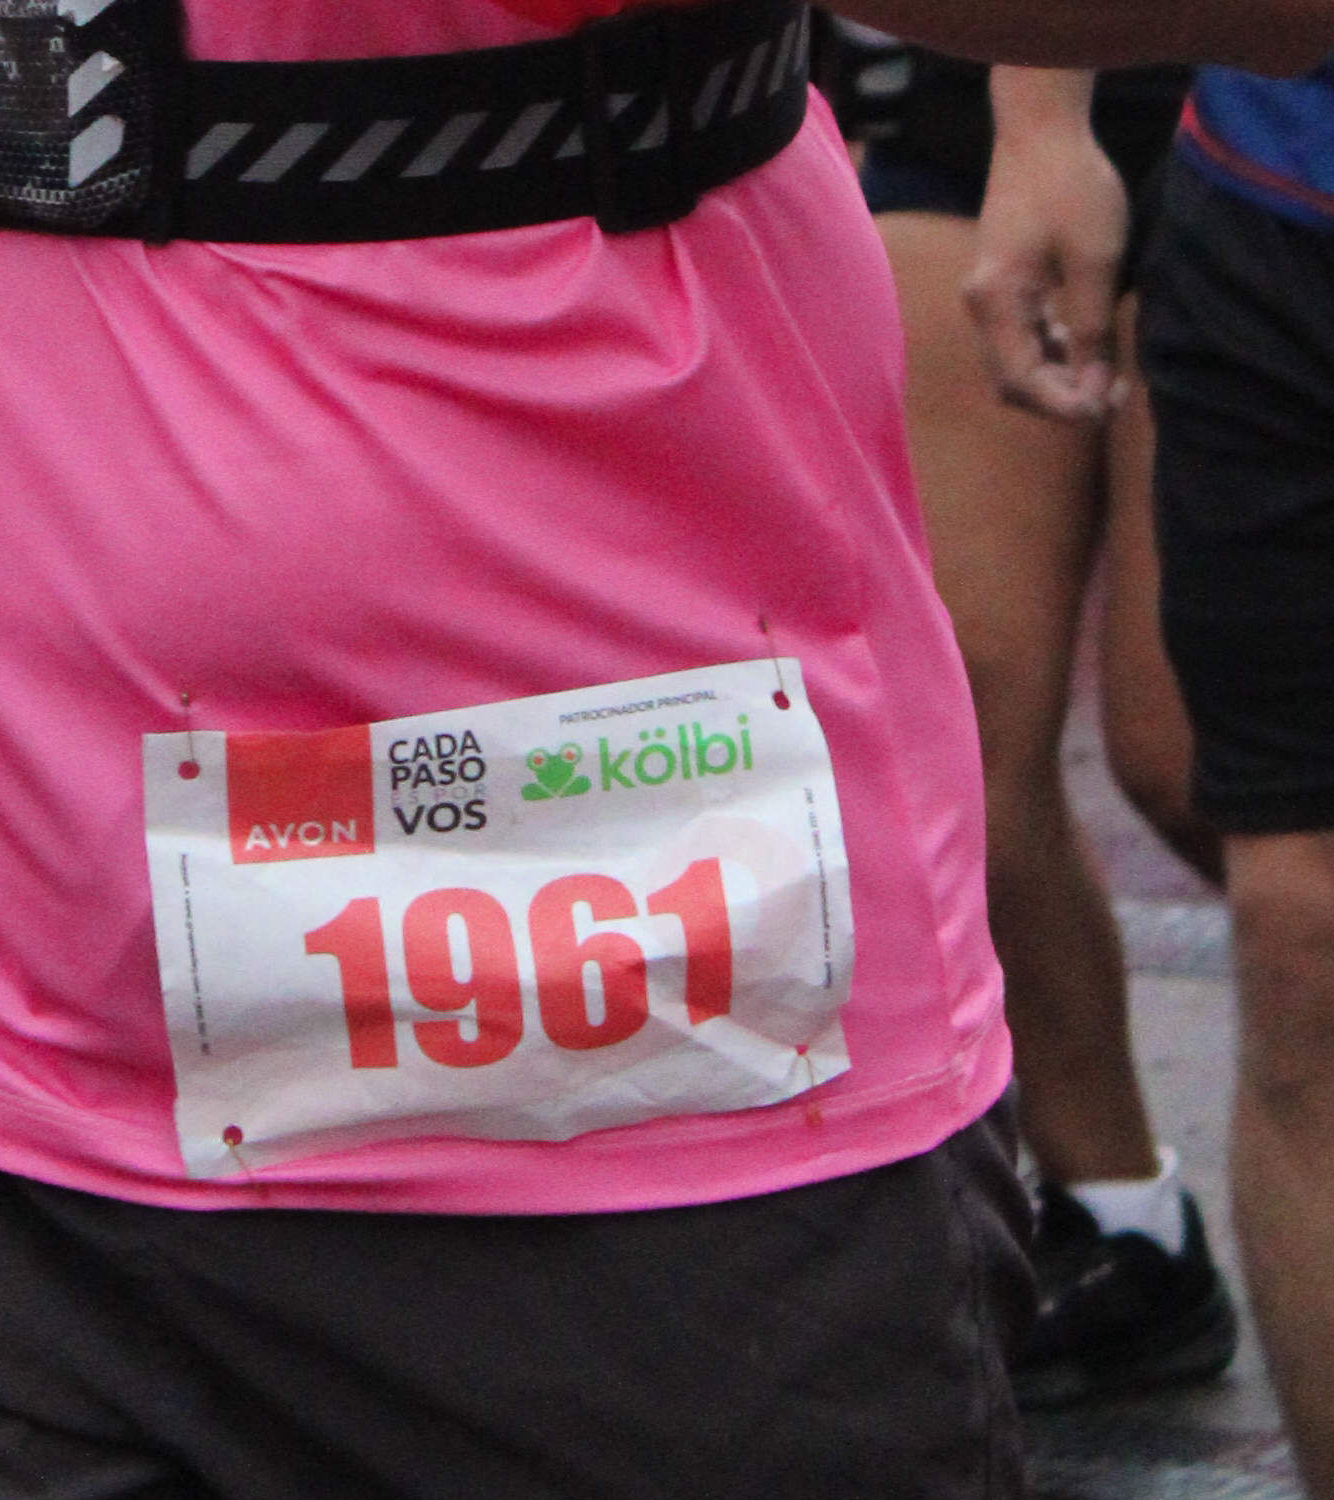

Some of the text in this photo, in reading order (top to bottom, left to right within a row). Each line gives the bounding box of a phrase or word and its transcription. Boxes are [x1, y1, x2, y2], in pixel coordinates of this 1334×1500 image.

[559, 690, 717, 725] PATROCINADOR PRINCIPAL
[388, 729, 482, 765] CADA
[597, 713, 753, 792] kölbi
[390, 756, 487, 790] PASO
[244, 819, 357, 851] AVON
[392, 799, 488, 836] VOS
[304, 857, 734, 1069] 1961
